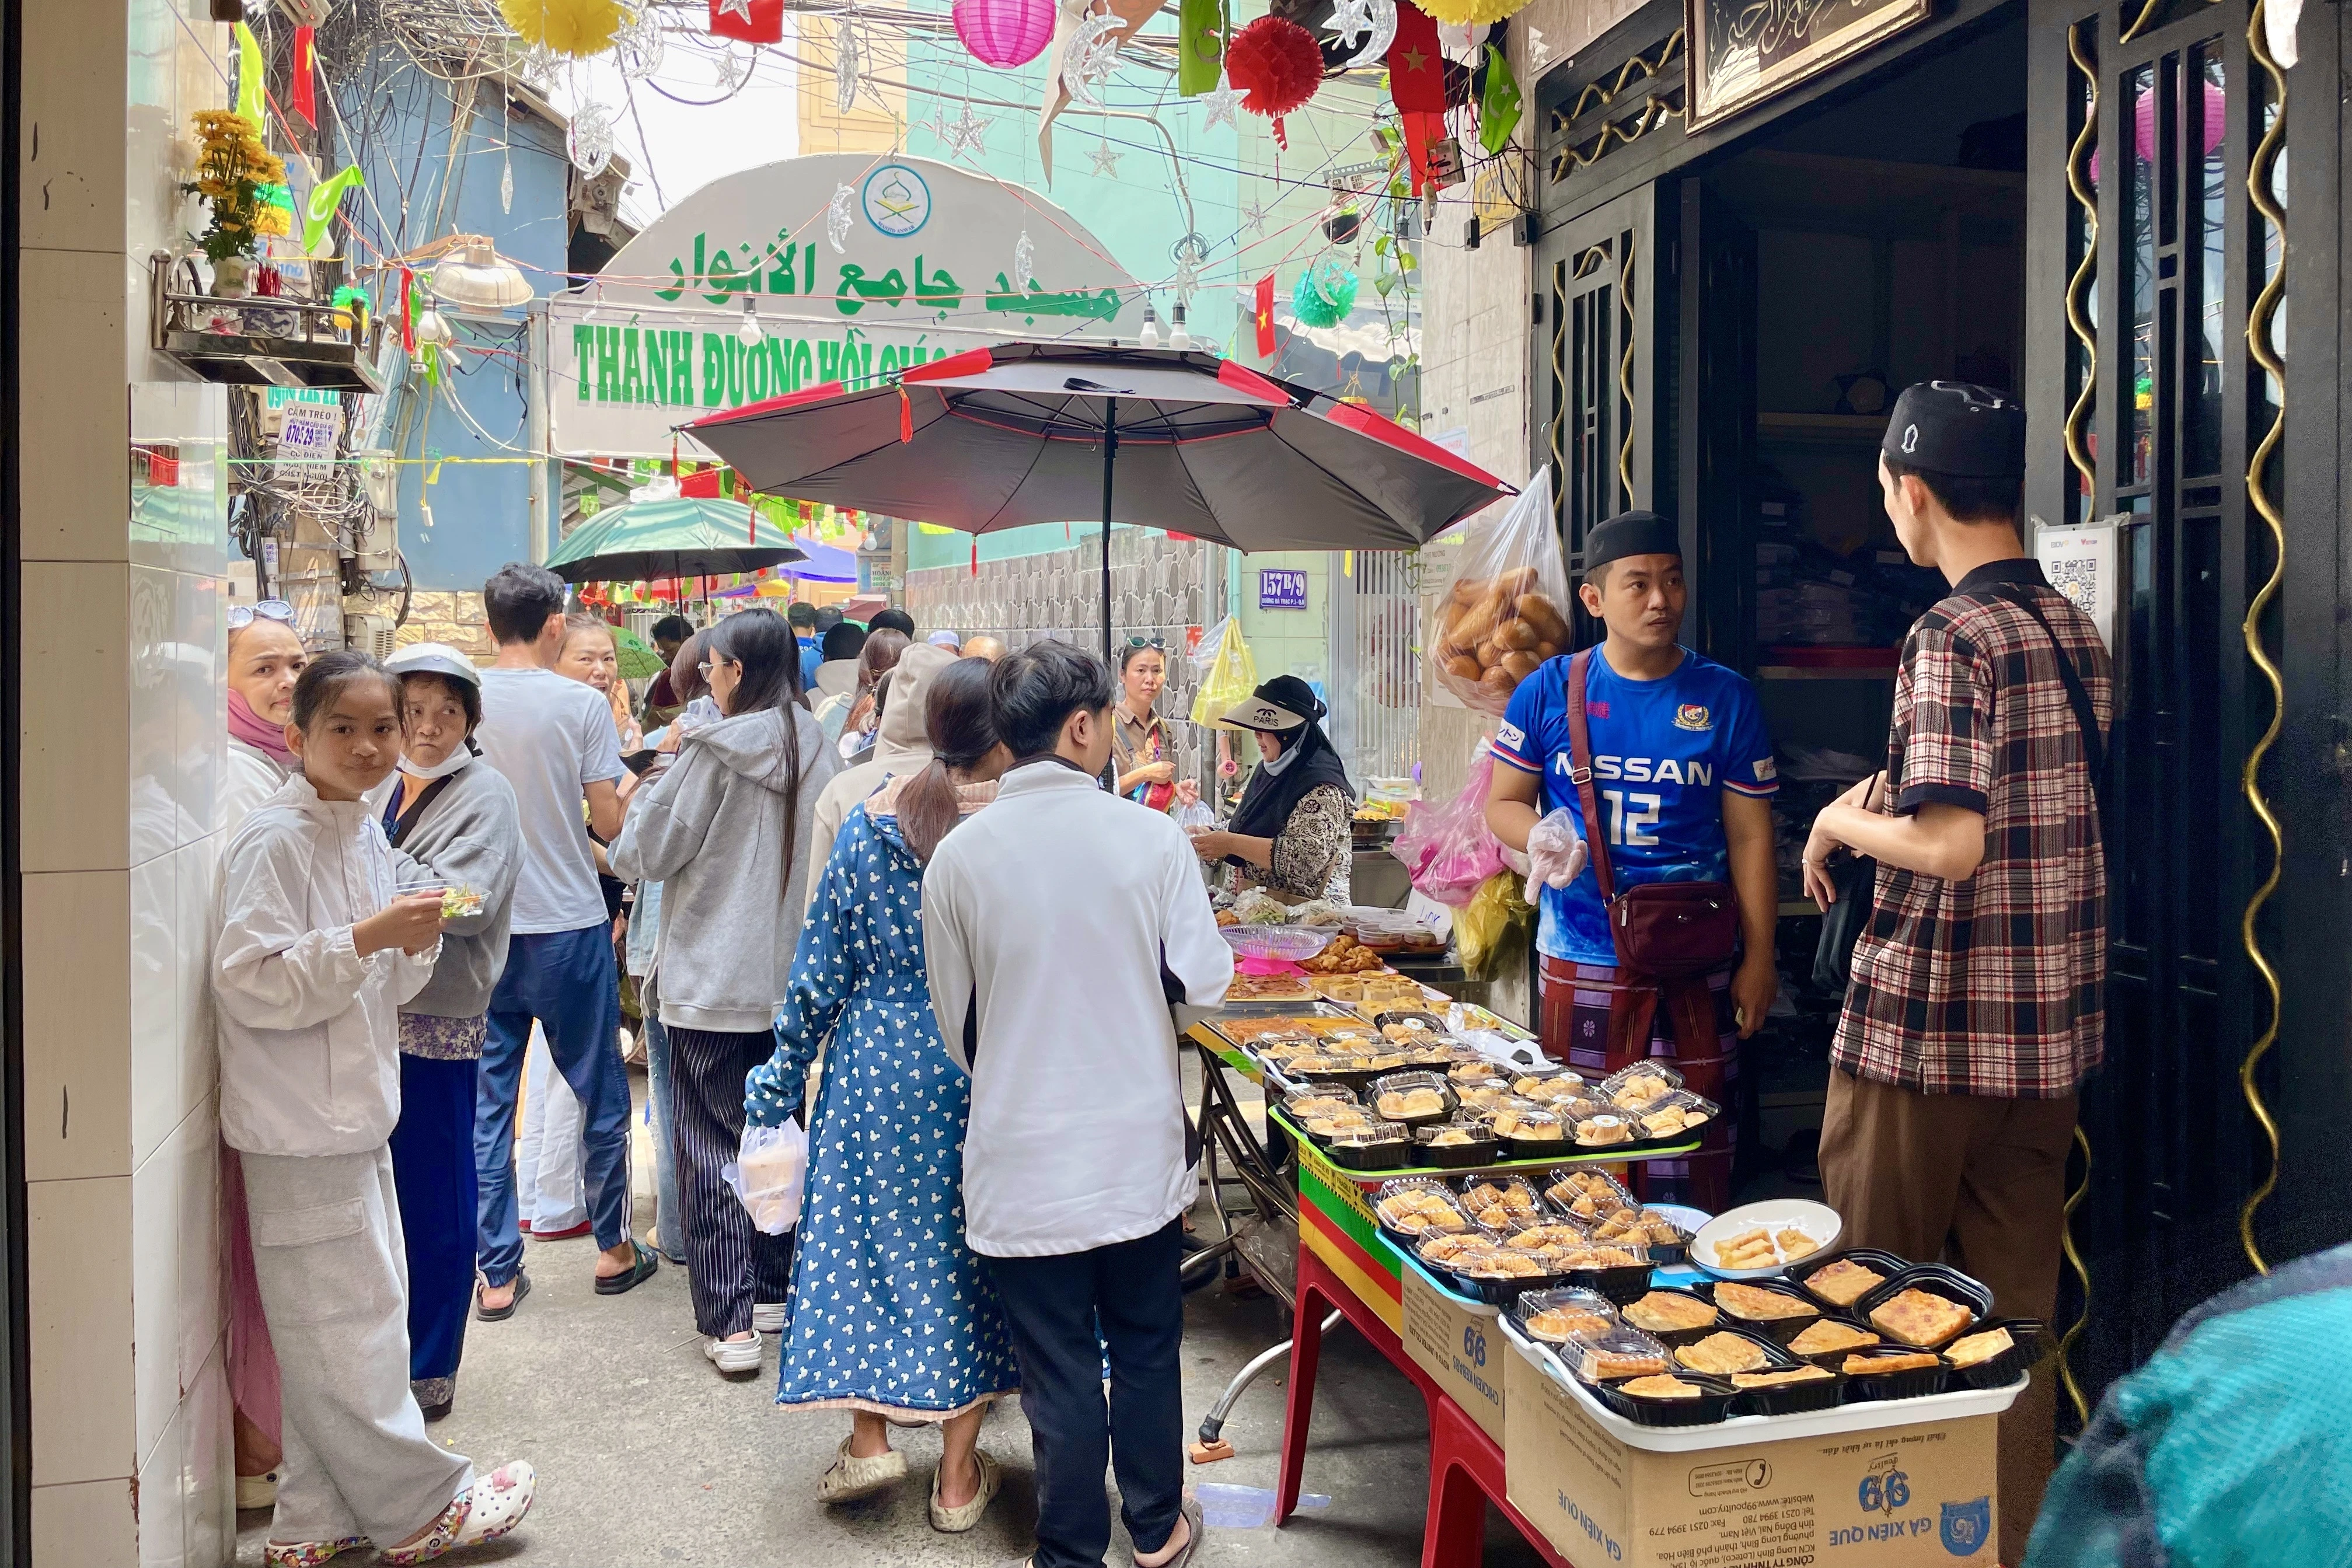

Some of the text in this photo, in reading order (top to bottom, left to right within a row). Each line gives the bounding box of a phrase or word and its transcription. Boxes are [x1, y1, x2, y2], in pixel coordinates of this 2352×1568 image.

[878, 221, 915, 233] MASJID ANWAR
[654, 228, 1122, 326] مسجد جامع الأنوار
[574, 313, 695, 405] THÁNH
[1262, 572, 1304, 596] 157B/9
[1254, 715, 1279, 727] PARIS
[1555, 752, 1712, 786] NSSAN
[1603, 790, 1661, 846] 12
[1474, 1374, 1499, 1406] CHICKEN
[1868, 1457, 1898, 1473] Poultry
[1859, 1471, 1910, 1511] 99
[1557, 1488, 1578, 1521] QUE
[1699, 1494, 1814, 1516] Website: www.99poultry.com
[1743, 1514, 1757, 1524] 780
[1760, 1511, 1778, 1522] 3994
[1782, 1509, 1800, 1518] 0251
[1649, 1527, 1665, 1536] 779
[1667, 1524, 1687, 1535] 3994
[1690, 1521, 1709, 1531] 0251
[1829, 1517, 1932, 1546] GÀ XIÊN QUE
[1718, 1529, 1739, 1539] Nam.
[1742, 1527, 1757, 1537] Việt
[1761, 1535, 1781, 1544] Long
[1696, 1545, 1712, 1558] phố
[1715, 1542, 1737, 1553] thành
[1777, 1546, 1796, 1554] Long
[1799, 1544, 1815, 1553] KCN
[1677, 1549, 1694, 1559] Biên
[1721, 1552, 1755, 1564] (Loteco),
[1757, 1549, 1774, 1559] Bình
[1700, 1556, 1719, 1567] quốc
[1774, 1558, 1785, 1567] TY
[1786, 1555, 1814, 1566] CÔNG
